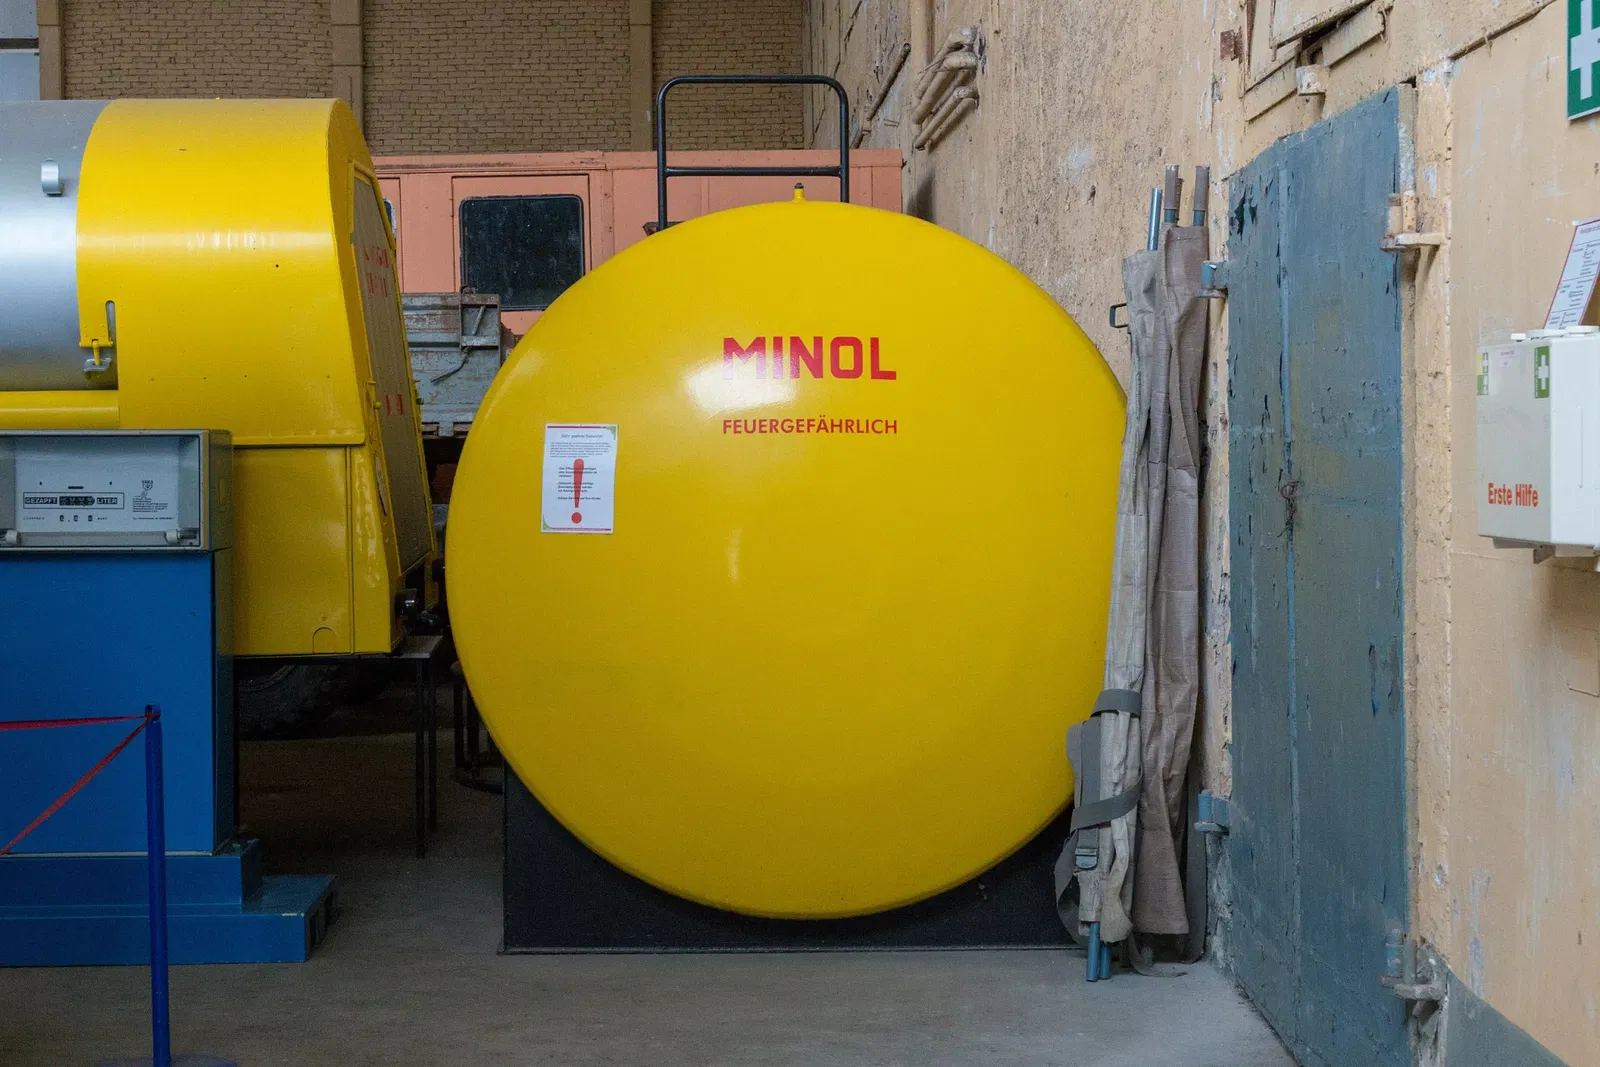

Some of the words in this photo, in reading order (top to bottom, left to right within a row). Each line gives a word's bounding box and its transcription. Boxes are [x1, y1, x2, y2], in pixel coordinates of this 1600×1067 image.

[723, 336, 897, 380] MINOL
[723, 415, 897, 434] FEUERGEFÄHRLICH
[1488, 482, 1512, 505] Erste
[1515, 483, 1538, 507] Hilfe
